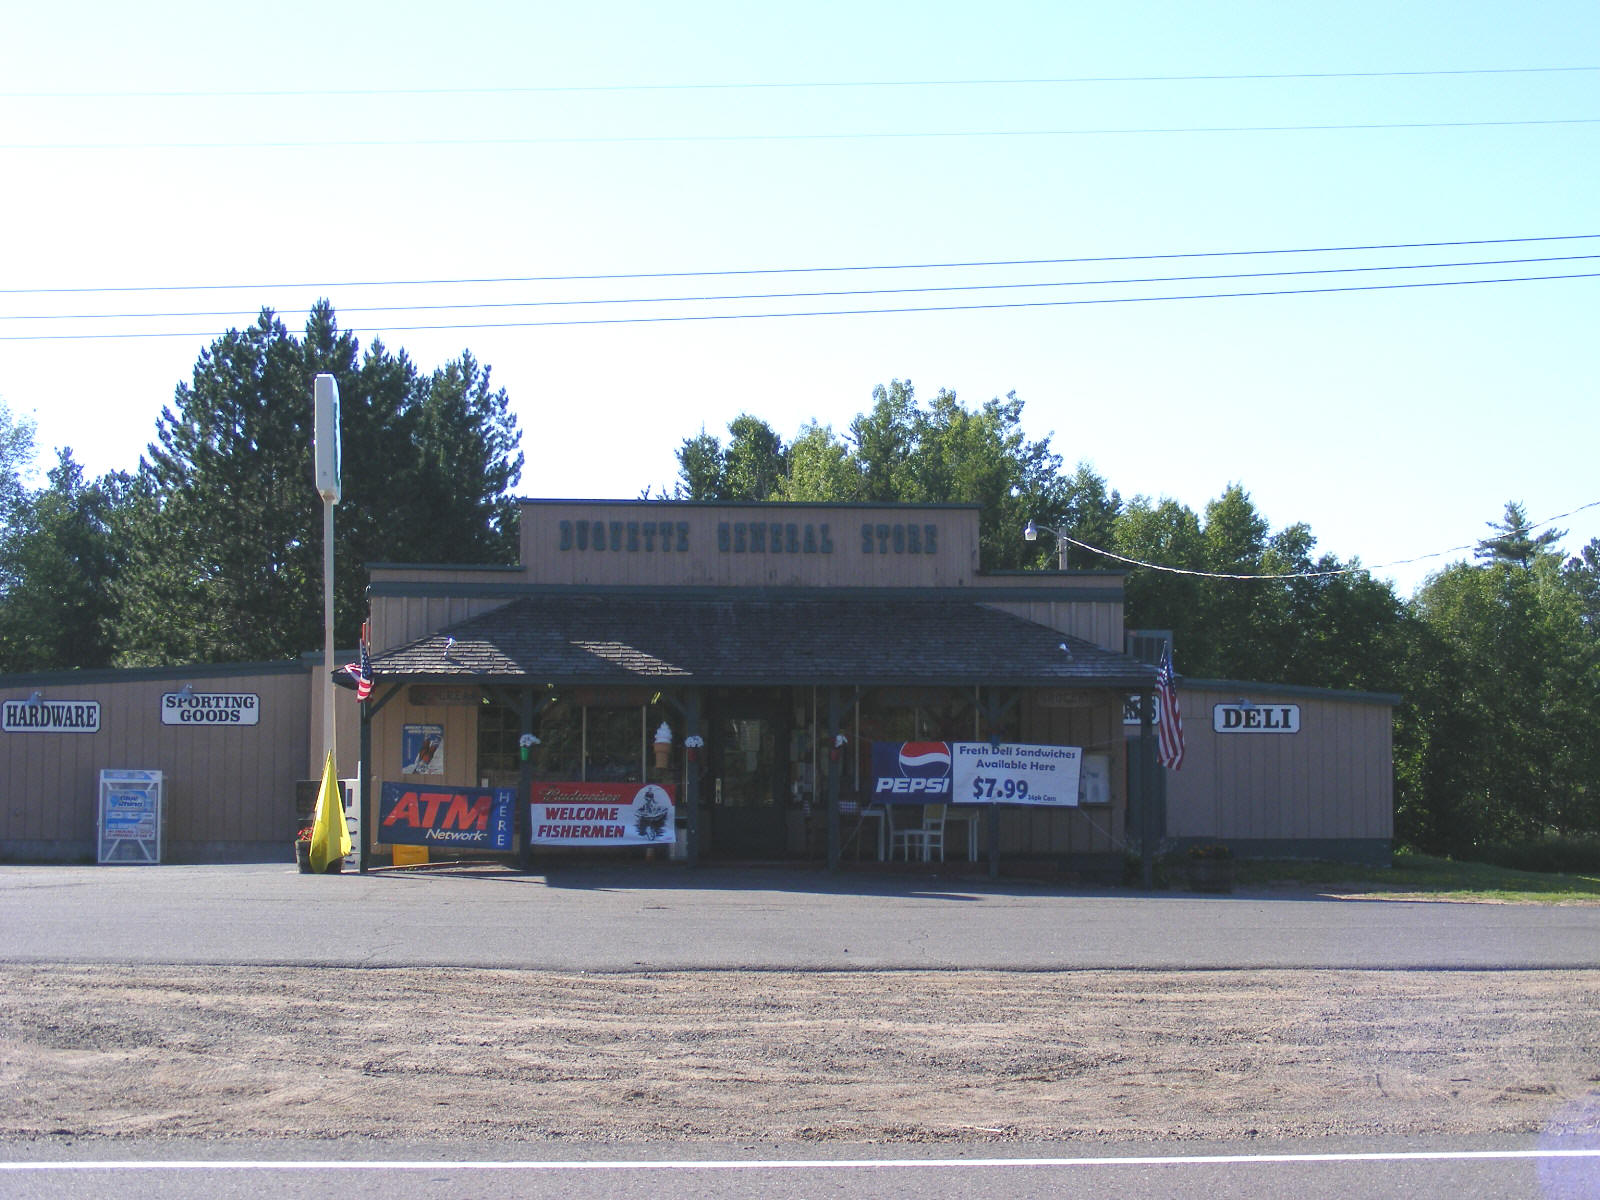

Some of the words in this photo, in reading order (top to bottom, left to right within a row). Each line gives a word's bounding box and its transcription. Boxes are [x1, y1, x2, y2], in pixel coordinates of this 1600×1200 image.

[559, 520, 690, 552] DUQUETTE
[717, 522, 834, 554] GENERAL
[861, 523, 938, 554] STORE
[165, 695, 255, 710] SPORTING
[6, 704, 97, 728] HARDWARE
[180, 709, 241, 723] GOODS
[1222, 708, 1292, 729] DELI
[959, 745, 989, 756] Fresh
[991, 745, 1013, 757] Deli
[1015, 747, 1076, 760] Sandwiches
[976, 759, 1028, 771] Available
[1030, 761, 1056, 772] Here
[875, 777, 950, 794] PEPSI
[973, 775, 1029, 800] $7.99
[383, 791, 493, 831] ATM
[496, 791, 510, 846] HERE
[545, 807, 620, 821] WELCOME
[425, 828, 484, 841] Network
[537, 825, 626, 839] FISHERMEN
